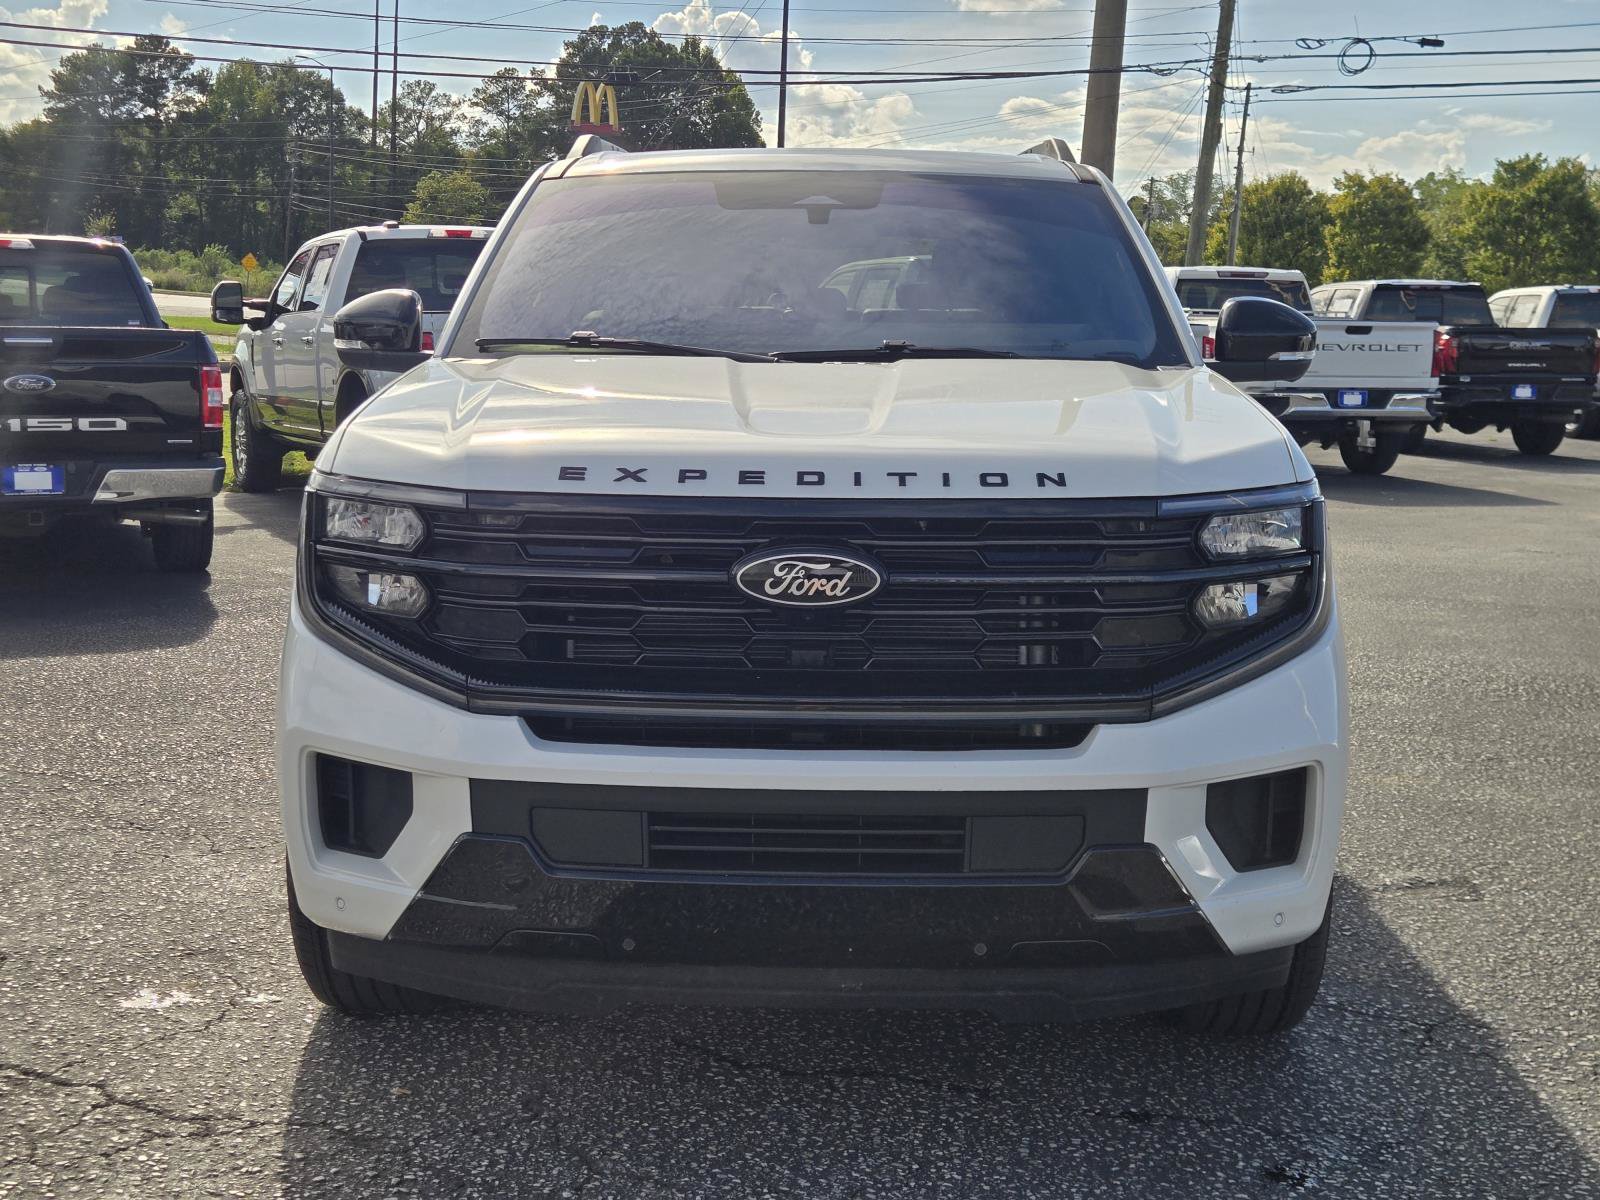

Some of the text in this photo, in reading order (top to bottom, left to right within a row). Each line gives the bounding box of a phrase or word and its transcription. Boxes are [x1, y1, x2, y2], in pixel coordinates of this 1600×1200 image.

[1315, 343, 1424, 352] EVROLET
[0, 417, 127, 432] 150
[557, 466, 1067, 488] EXPEDITION
[764, 560, 853, 597] Ford
